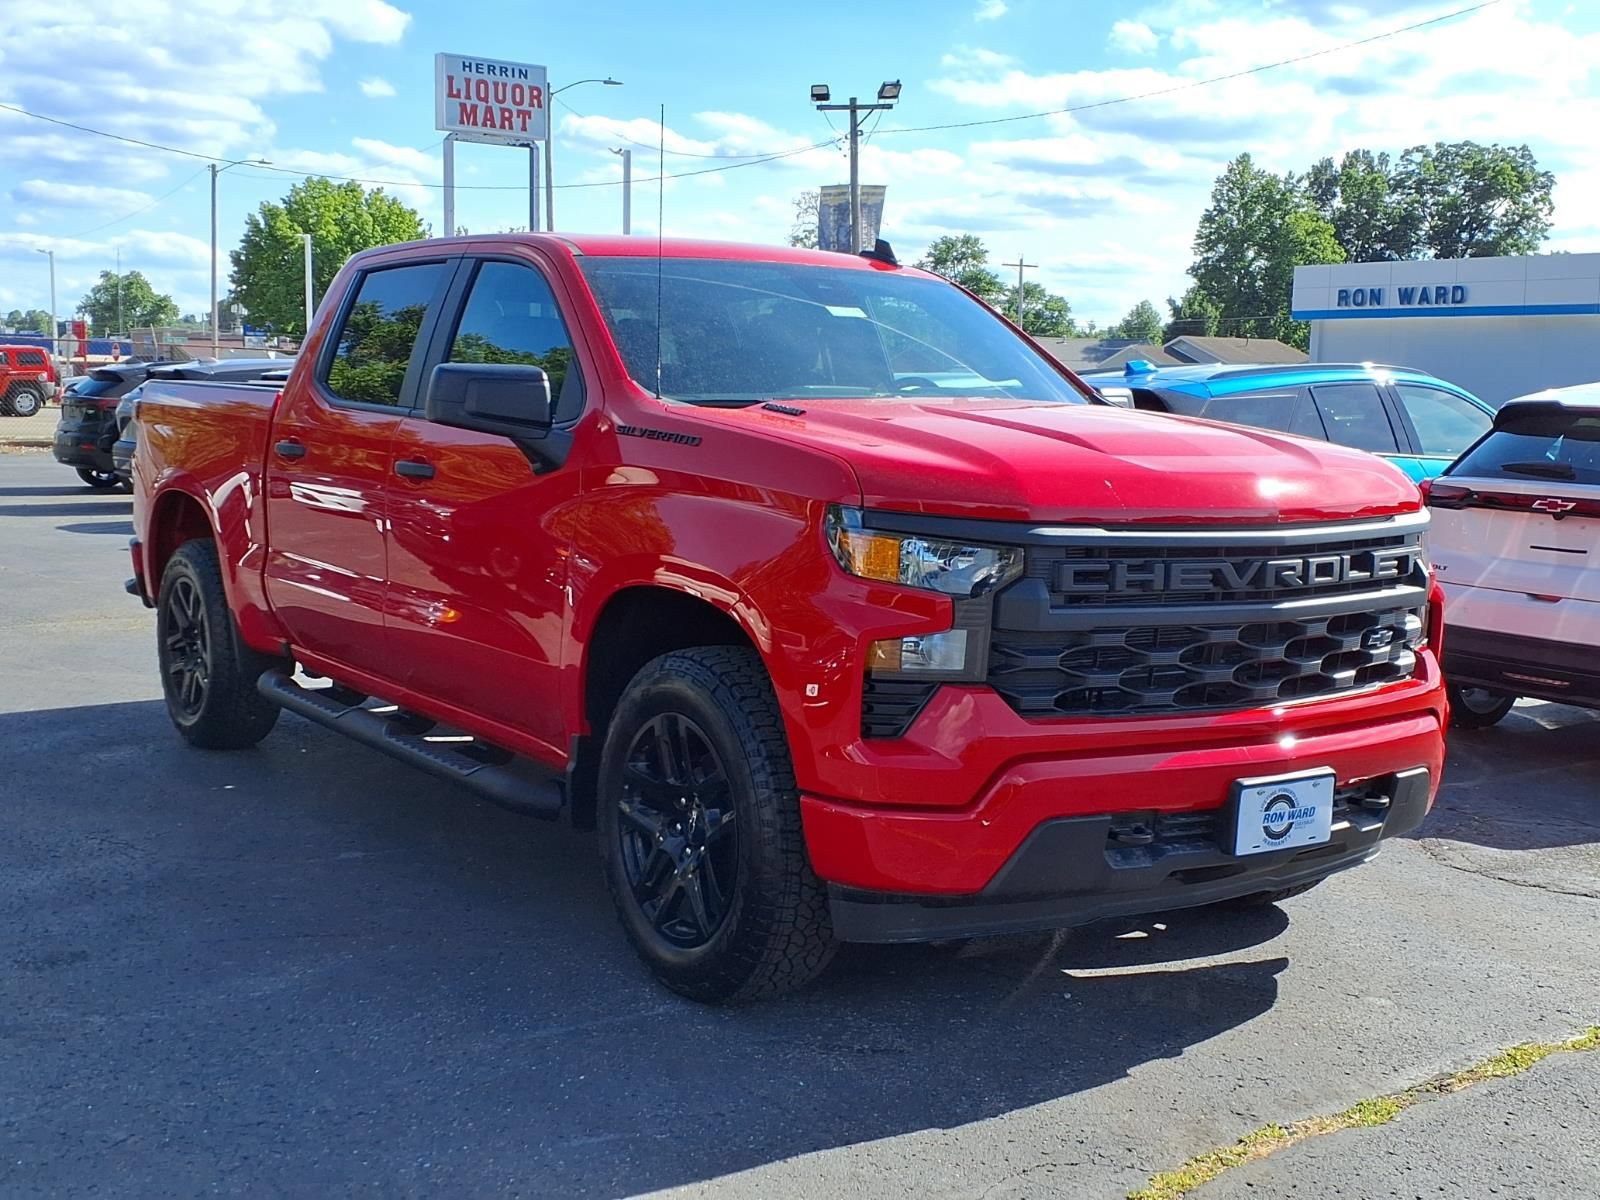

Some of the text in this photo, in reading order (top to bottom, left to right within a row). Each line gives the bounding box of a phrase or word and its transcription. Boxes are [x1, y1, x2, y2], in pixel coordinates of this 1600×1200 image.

[462, 60, 529, 80] HERRIN
[447, 74, 543, 109] LIQUOR
[458, 102, 532, 133] MART
[1337, 284, 1467, 308] RON WARD
[1262, 811, 1286, 825] RON
[1287, 806, 1316, 821] WARD
